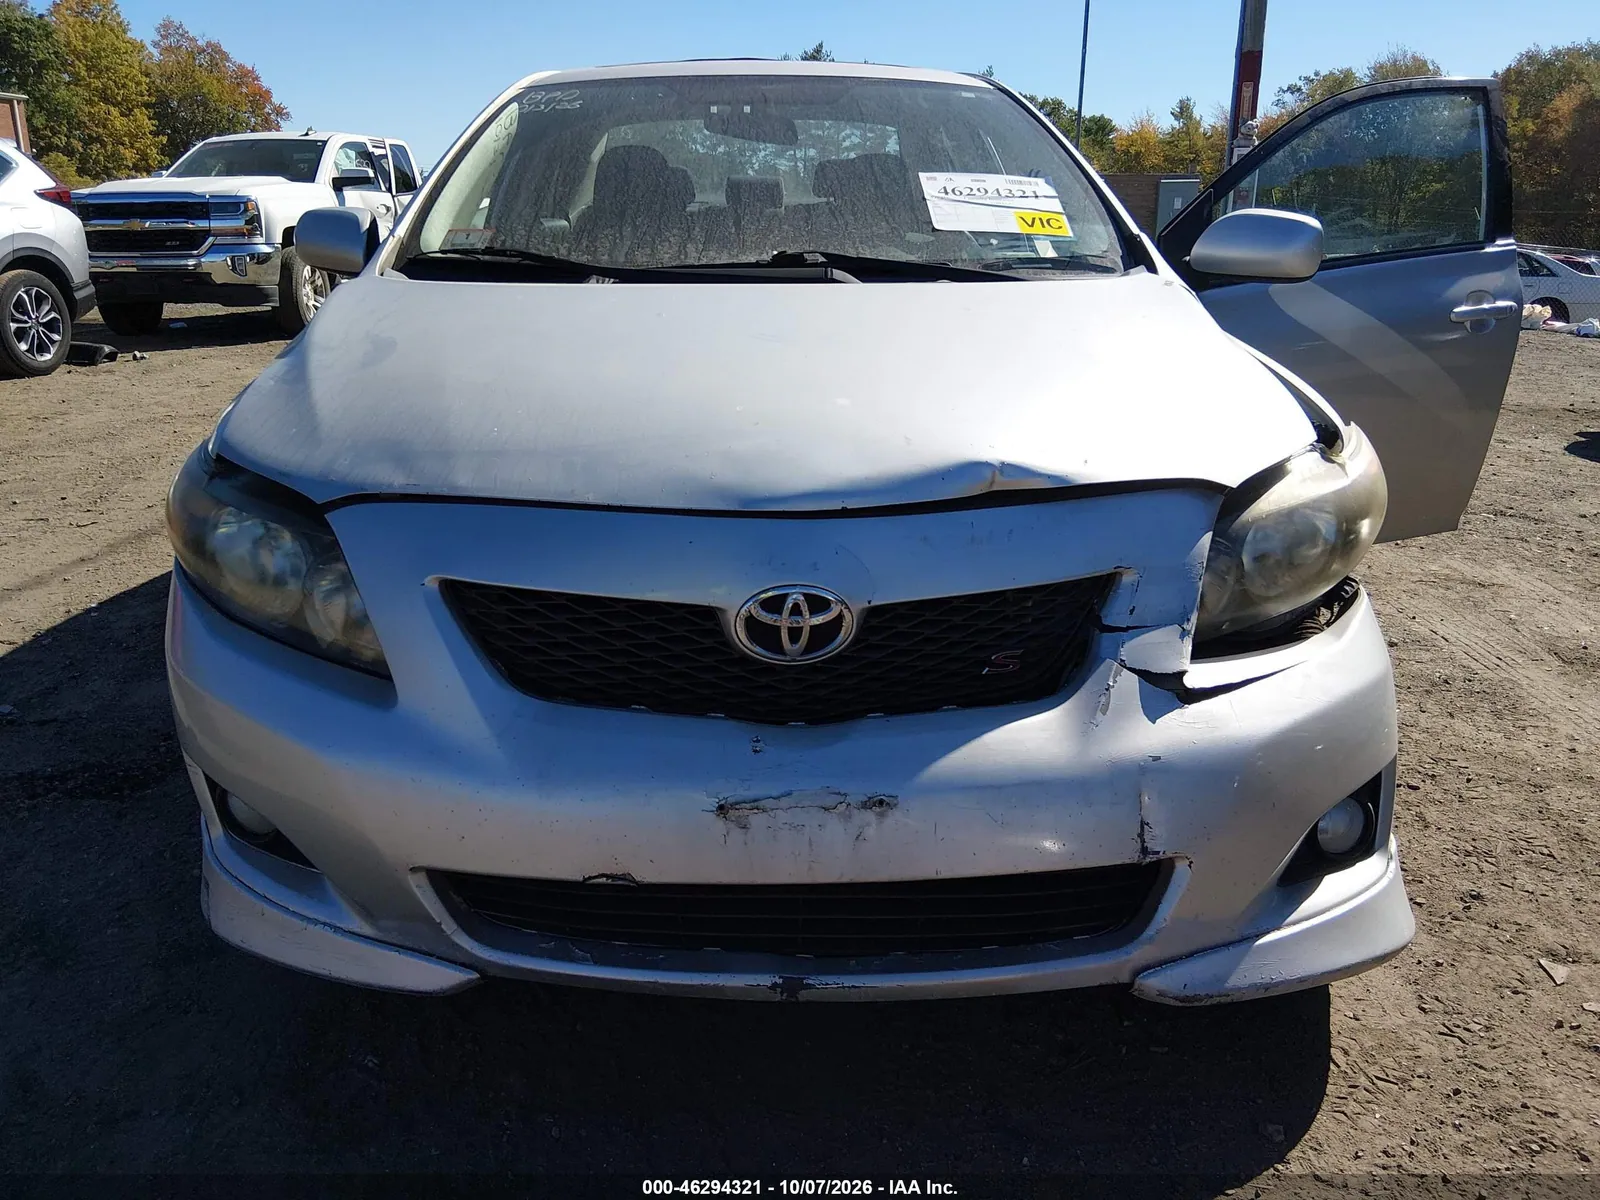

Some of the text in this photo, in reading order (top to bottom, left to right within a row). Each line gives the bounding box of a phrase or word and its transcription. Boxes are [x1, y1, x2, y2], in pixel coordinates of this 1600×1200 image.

[937, 186, 1040, 199] 46294321
[1019, 216, 1064, 230] VIC
[981, 648, 1026, 675] S
